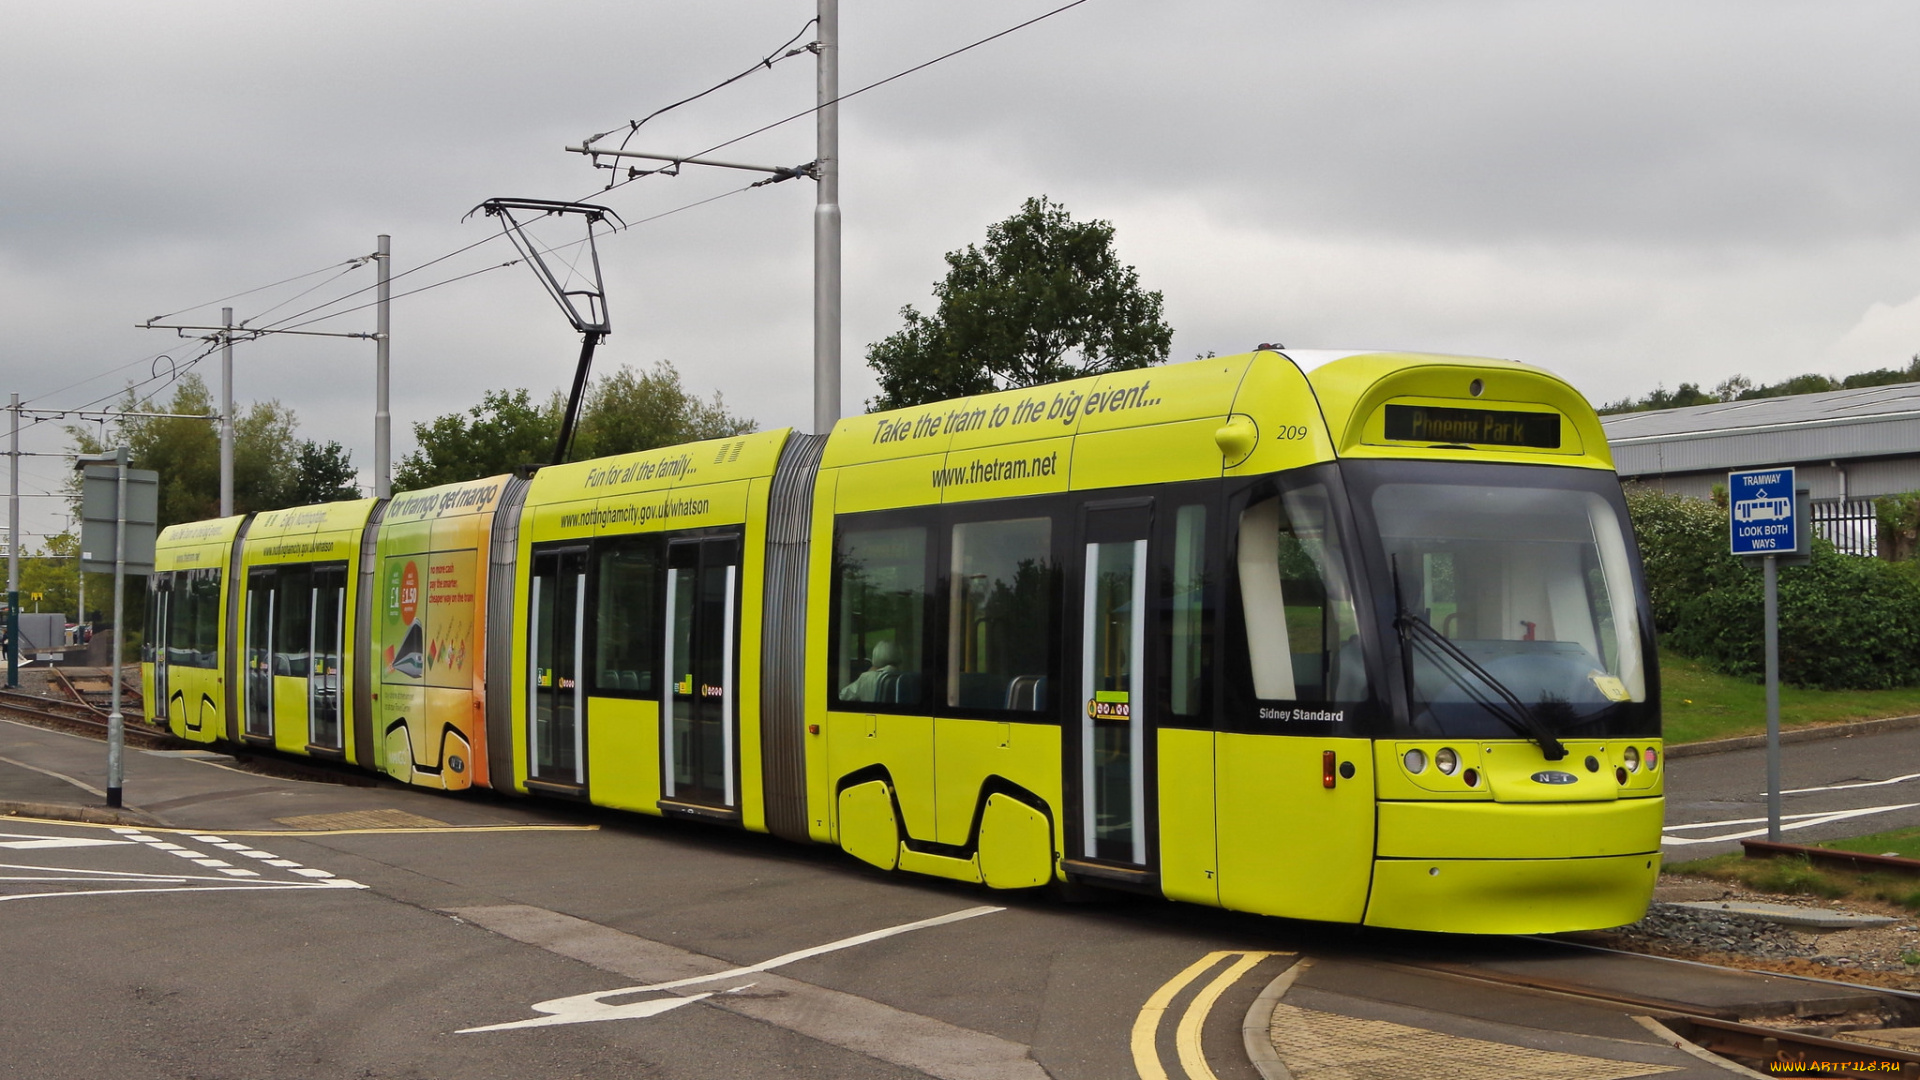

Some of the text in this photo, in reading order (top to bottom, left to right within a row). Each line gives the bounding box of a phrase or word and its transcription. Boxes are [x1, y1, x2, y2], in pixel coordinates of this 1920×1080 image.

[872, 380, 1162, 445] Take the tram to the big event...
[1277, 425, 1307, 440] 209
[1412, 410, 1525, 442] Phoenix Park
[584, 453, 697, 488] Fun for all the family...
[932, 451, 1057, 488] www.thetram.net
[1743, 474, 1781, 486] TRAMWAY
[387, 497, 404, 518] for
[437, 487, 463, 517] get
[458, 484, 498, 512] mango
[560, 498, 709, 528] www.nottinghamcity.gov.uk/whatson
[1739, 524, 1788, 537] LOOK BOTH
[1752, 538, 1776, 549] WAYS
[390, 587, 399, 608] £1
[1259, 708, 1344, 722] Sidney Standard
[1540, 773, 1569, 782] NET
